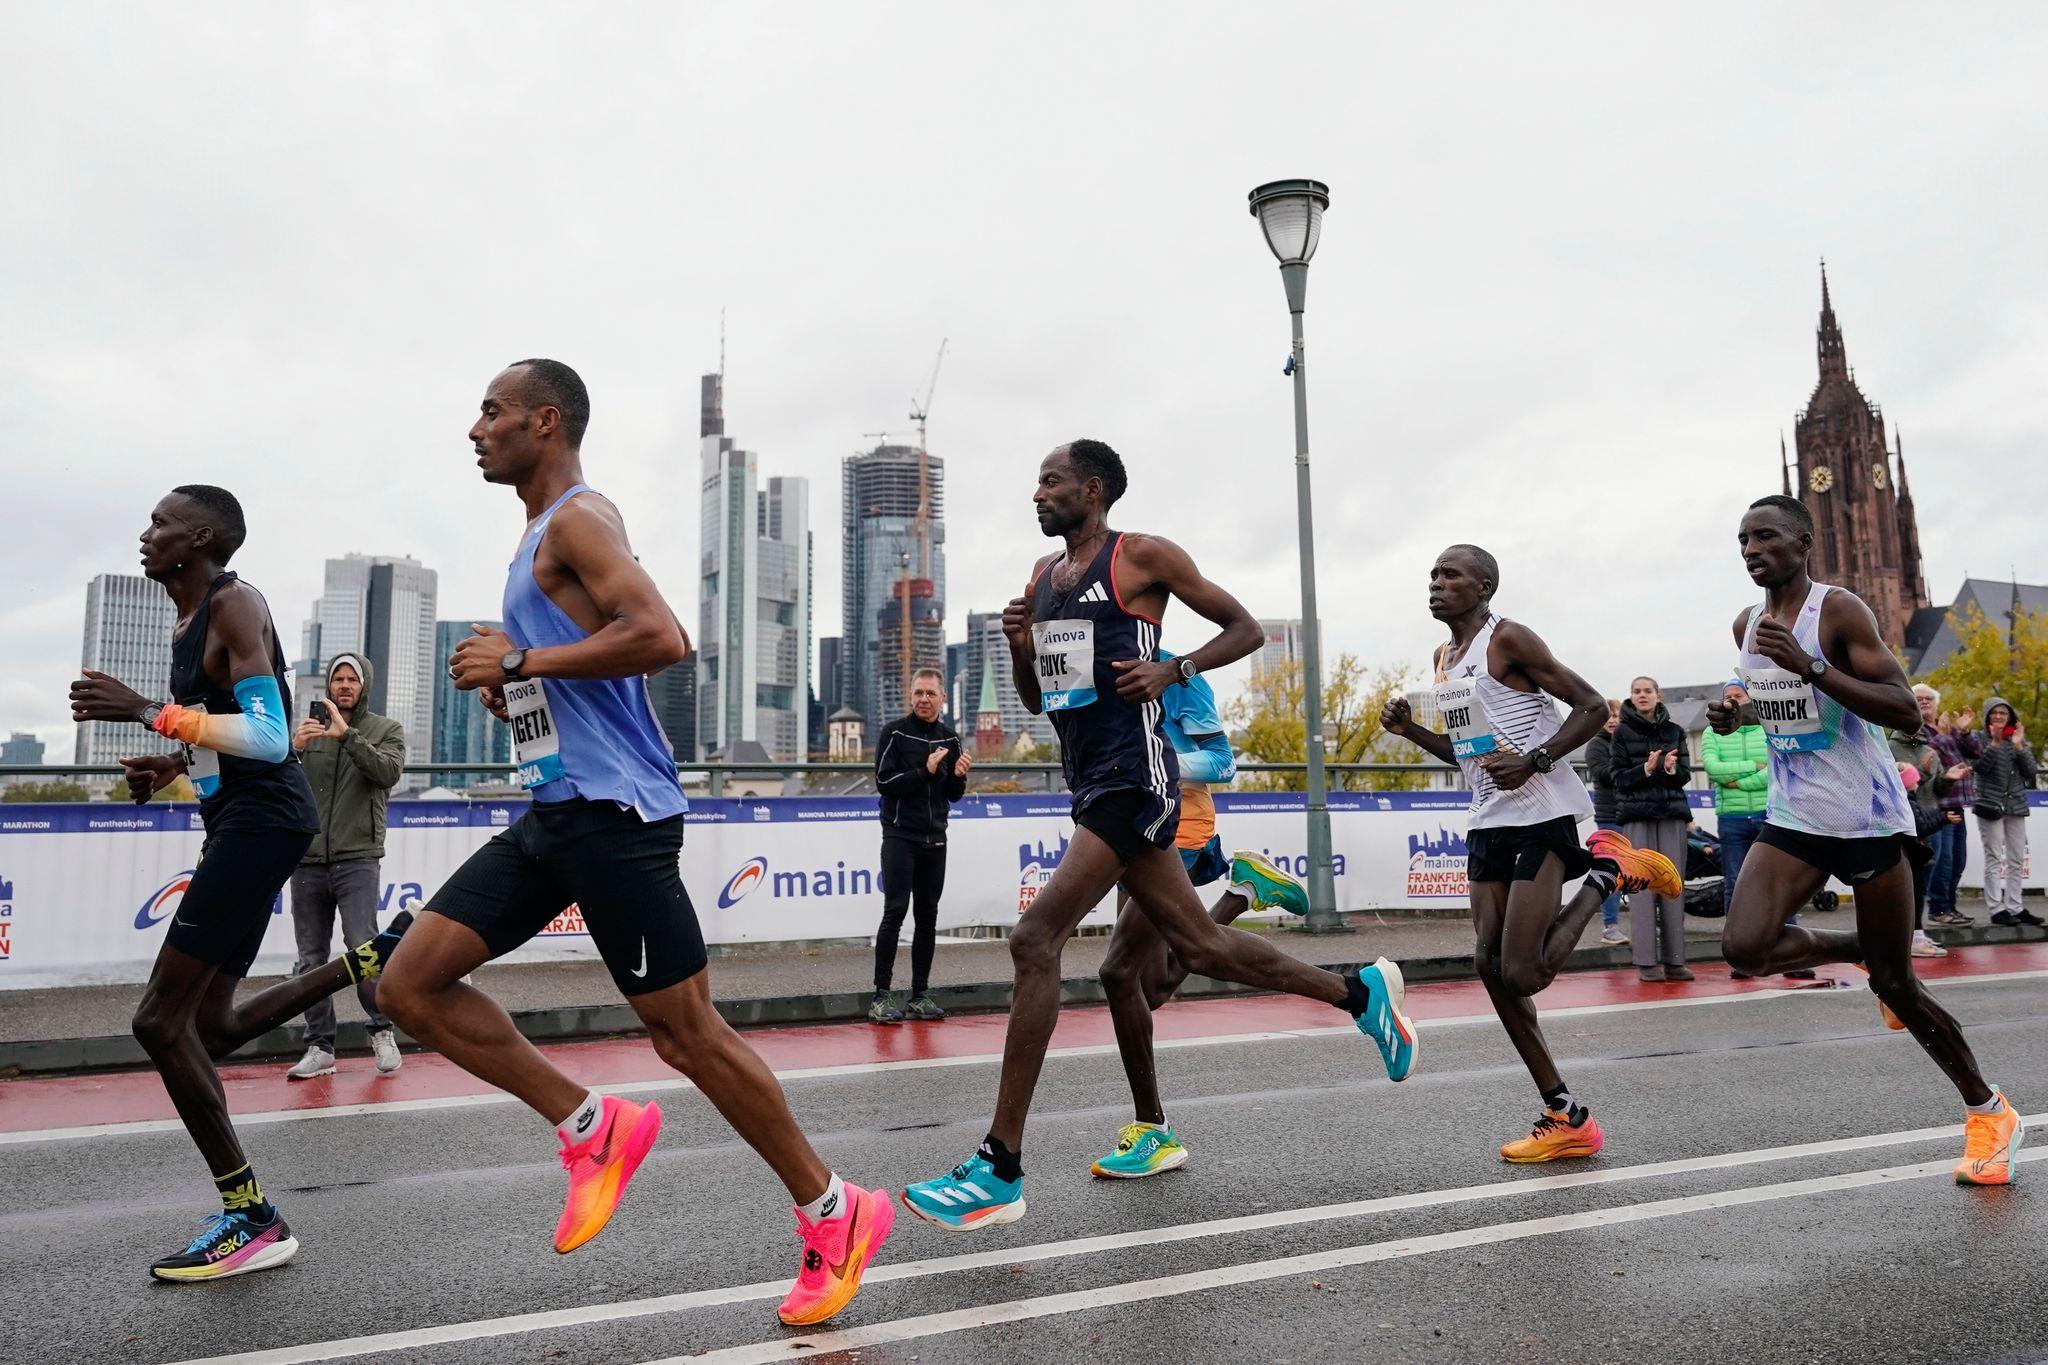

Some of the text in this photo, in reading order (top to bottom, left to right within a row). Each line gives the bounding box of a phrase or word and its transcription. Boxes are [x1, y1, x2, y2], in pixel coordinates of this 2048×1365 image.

[1040, 653, 1068, 677] GUYE
[1440, 688, 1471, 702] mainova
[3, 821, 50, 829] MARATHON
[89, 819, 153, 829] #runtheskyline
[403, 816, 459, 825] #runtheskyline
[1136, 1136, 1161, 1162] HOKA
[205, 1230, 251, 1264] HOKA
